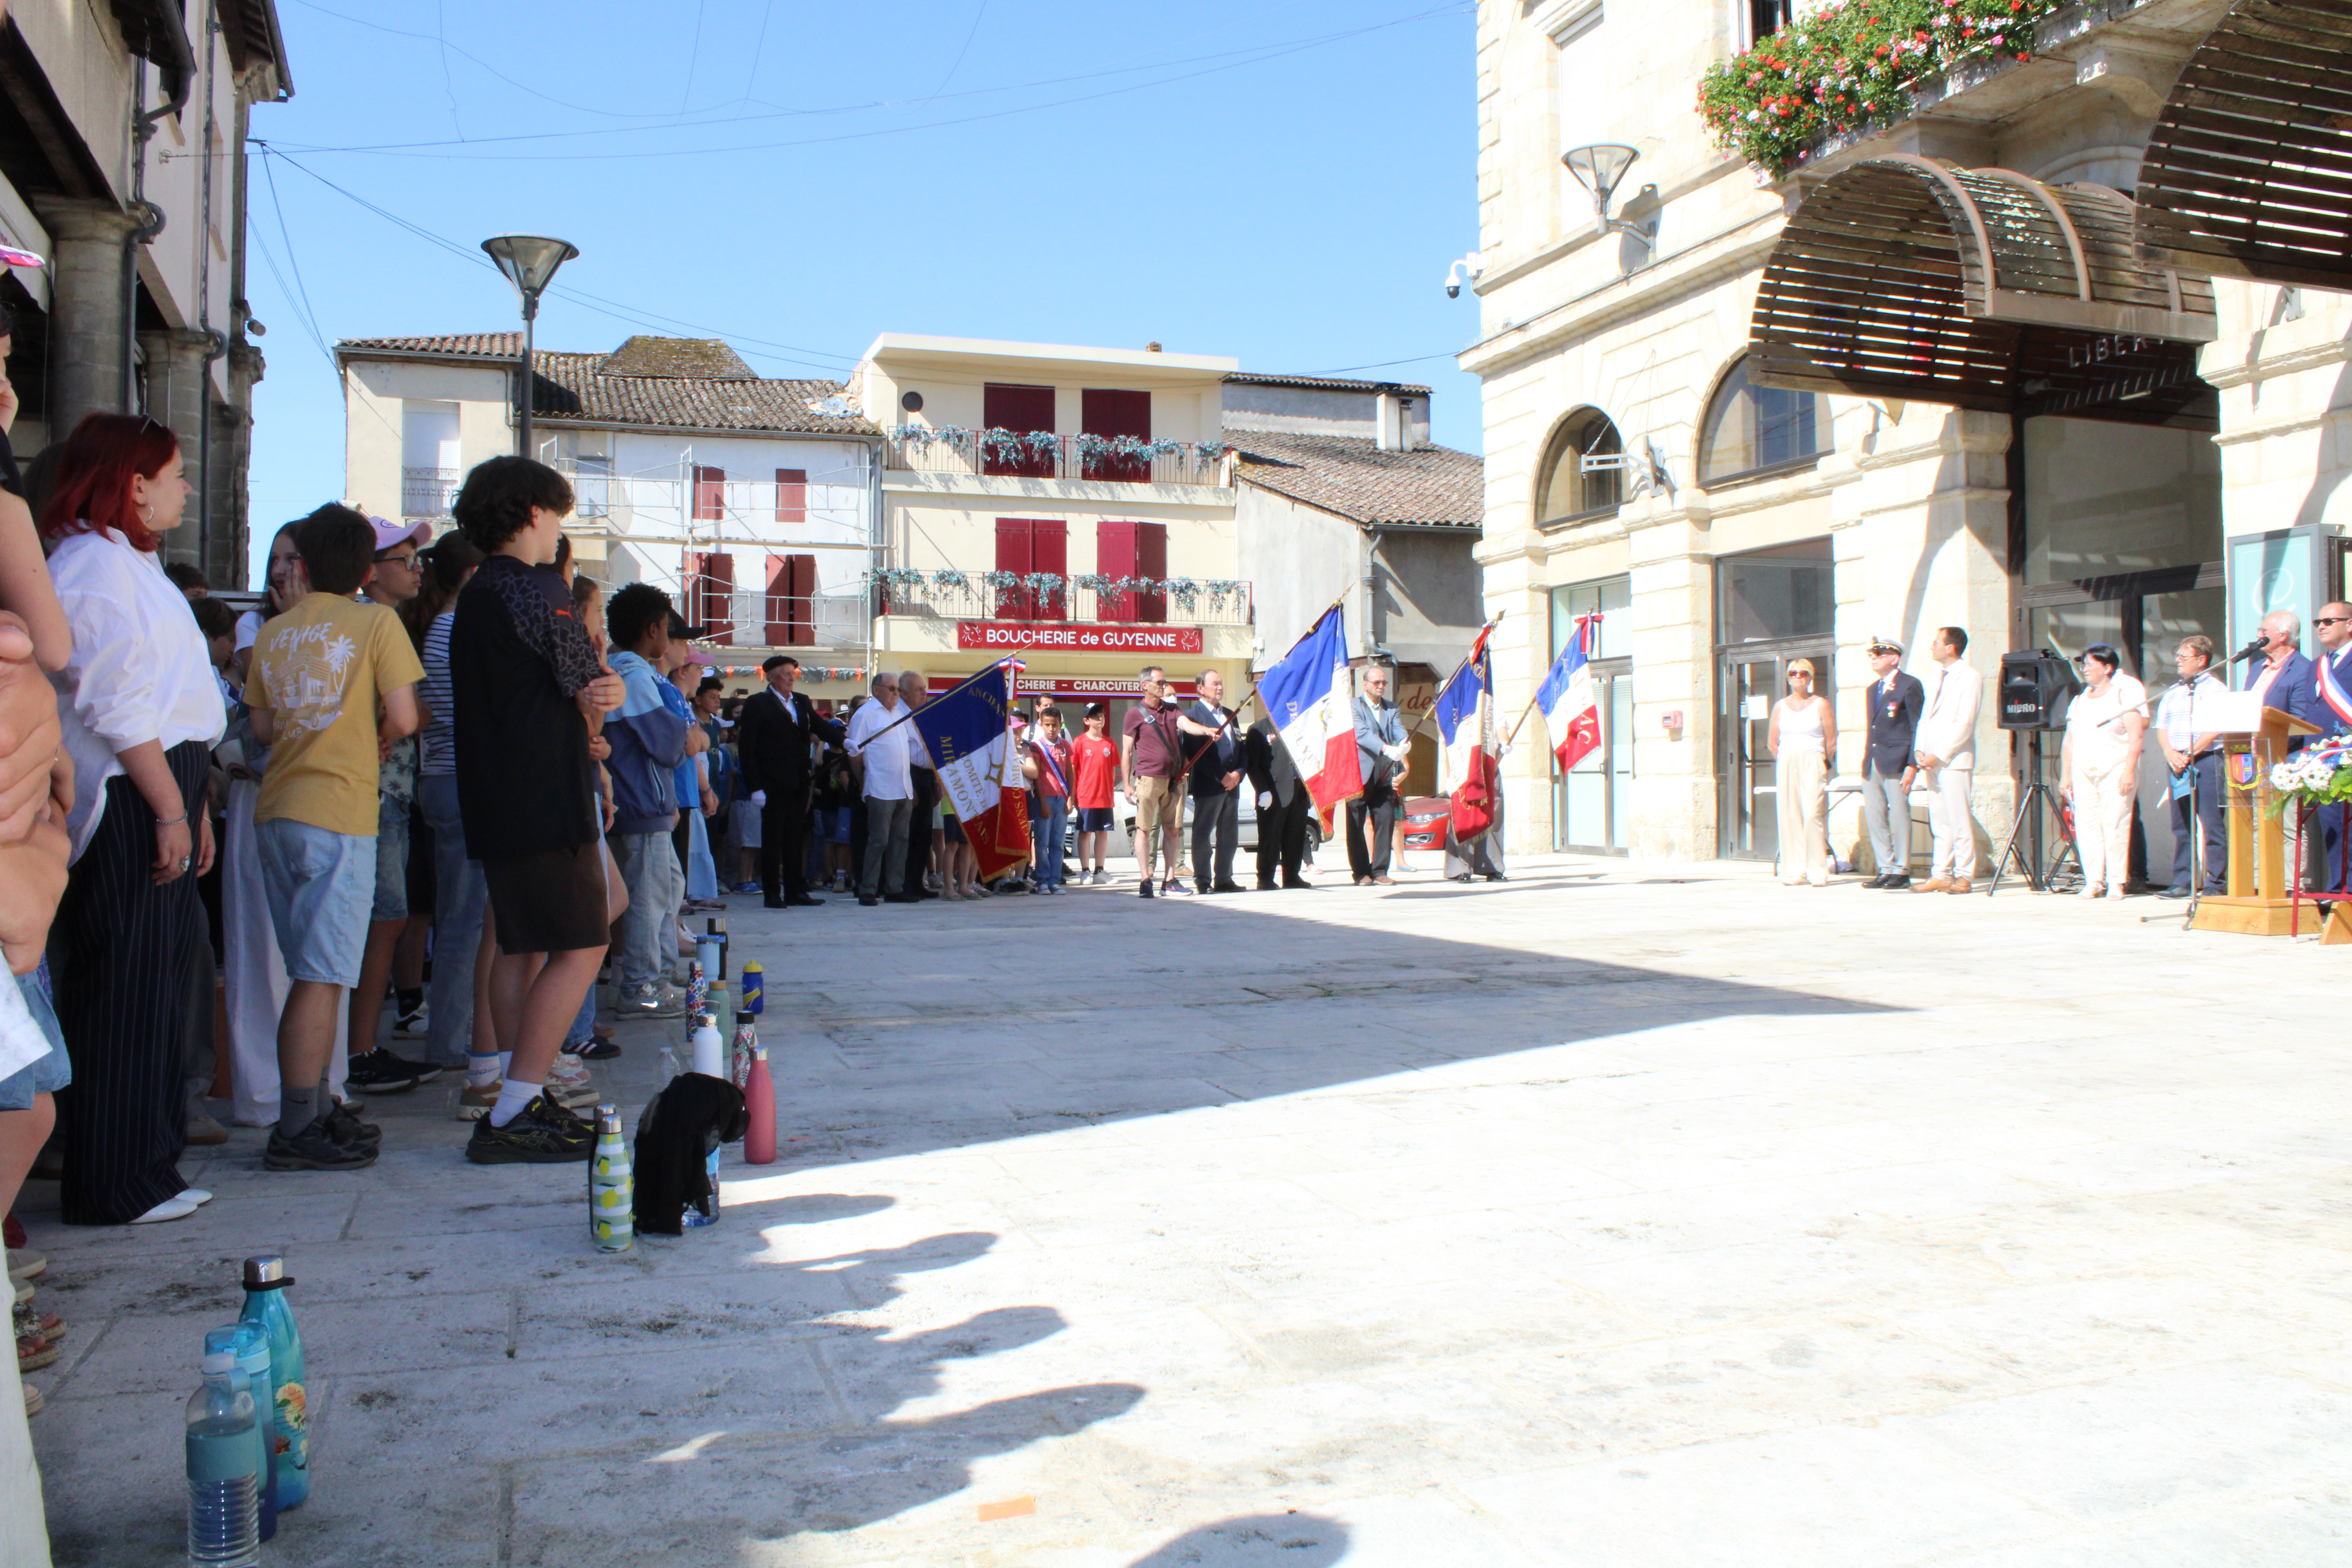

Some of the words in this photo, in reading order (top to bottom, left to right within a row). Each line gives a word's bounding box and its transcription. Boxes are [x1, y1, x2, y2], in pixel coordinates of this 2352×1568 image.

[2069, 334, 2165, 368] LIBER
[986, 629, 1076, 646] BOUCHERIE
[1080, 632, 1100, 646] de
[1102, 631, 1177, 648] GUYENNE
[967, 686, 1005, 718] ANCIENS
[1005, 679, 1056, 690] CHERIE
[1407, 686, 1432, 710] de
[1285, 701, 1298, 722] DE
[1292, 726, 1324, 777] GUYEN
[940, 735, 990, 845] MIRAMONTAIS
[960, 751, 986, 797] COMITÉ
[1012, 751, 1022, 799] COMBAT
[1014, 801, 1029, 837] CIENS
